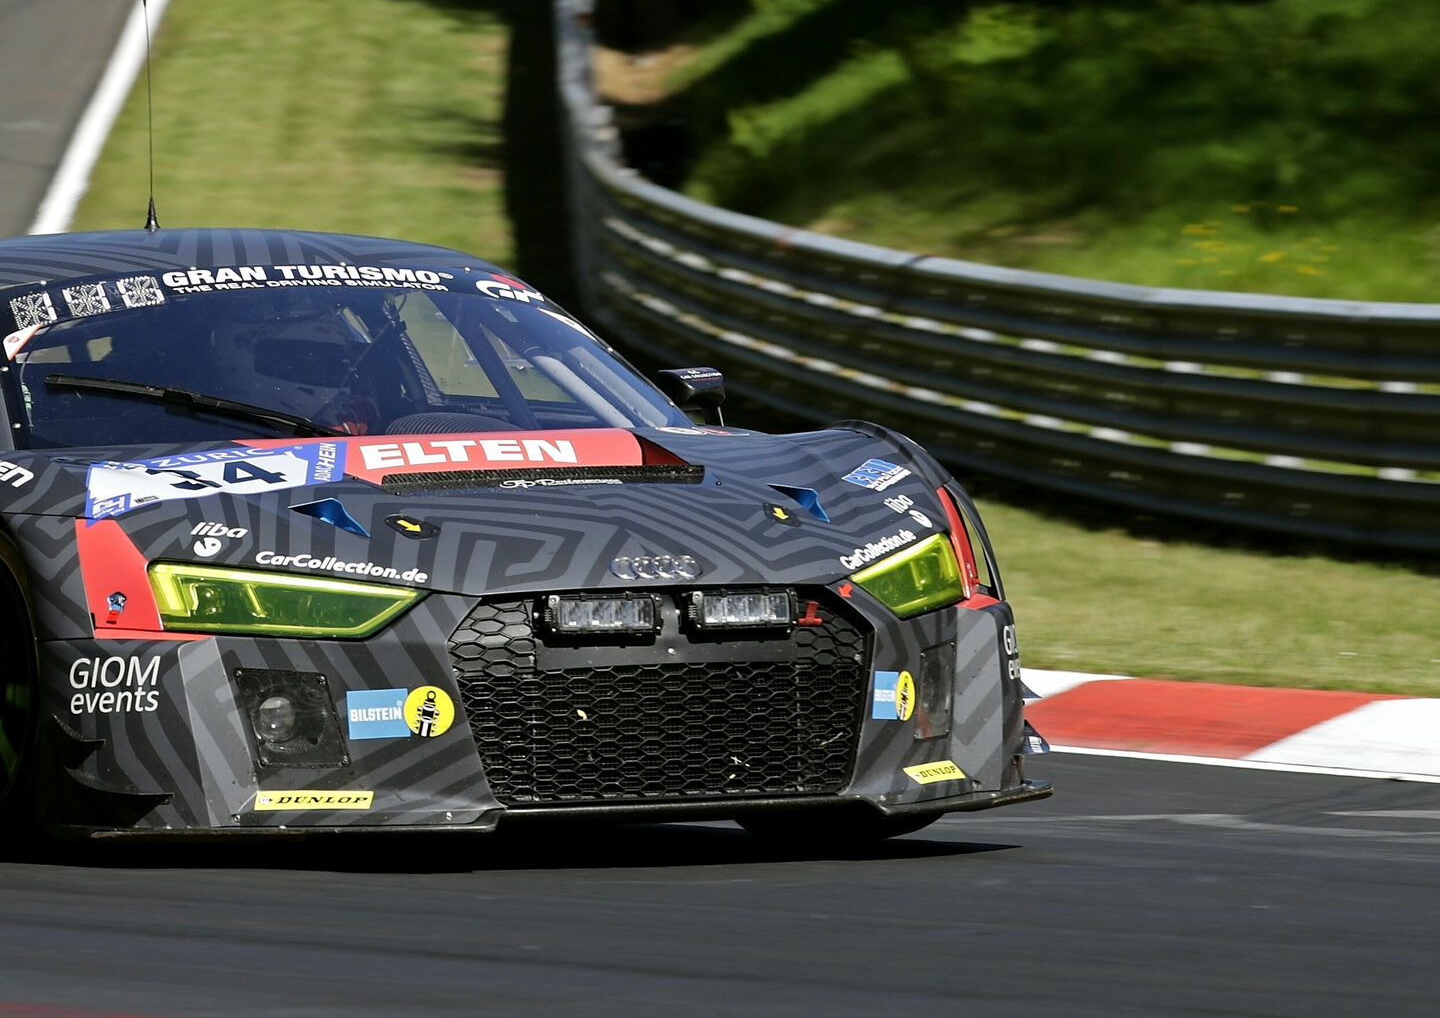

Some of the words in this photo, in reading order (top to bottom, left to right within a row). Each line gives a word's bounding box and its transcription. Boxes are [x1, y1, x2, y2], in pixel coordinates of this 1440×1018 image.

[162, 266, 267, 287] GRAN
[173, 286, 206, 295] THE
[209, 282, 266, 293] REAL
[268, 278, 344, 289] DRIVING
[346, 279, 449, 292] SIMULATOR
[359, 439, 578, 470] ELTEN
[190, 522, 248, 539] liba
[840, 529, 917, 570] CarCollection.de
[255, 550, 428, 584] CarCollection.de
[69, 655, 161, 689] GIOM
[70, 687, 160, 715] events
[350, 707, 403, 722] BILSTEIN
[919, 765, 957, 779] DUNLOP
[275, 796, 369, 805] DUNLOP
